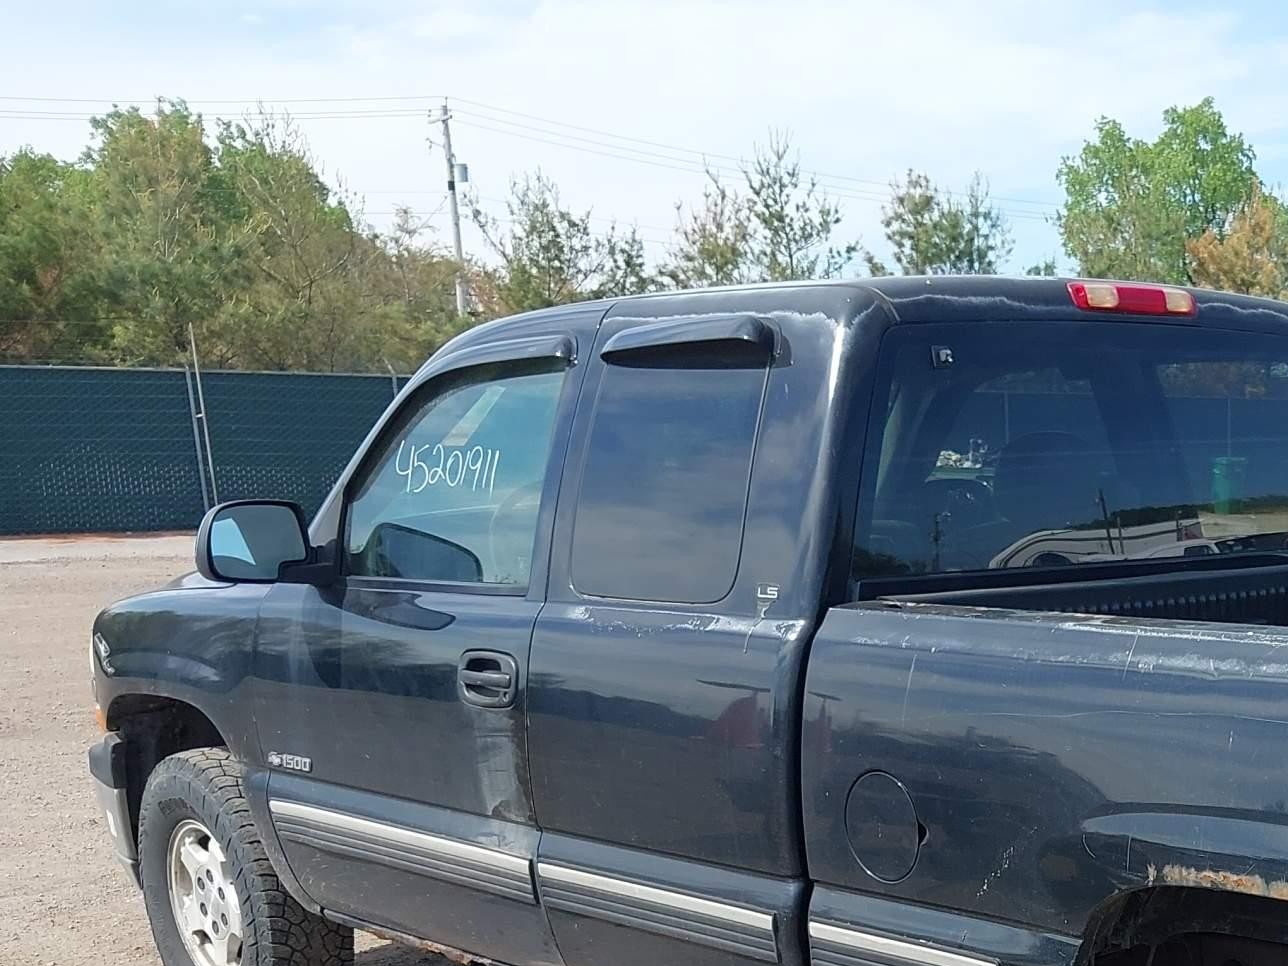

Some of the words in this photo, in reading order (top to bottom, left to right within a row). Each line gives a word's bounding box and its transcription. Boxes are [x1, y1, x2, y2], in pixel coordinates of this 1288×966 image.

[395, 439, 500, 498] 45201911
[757, 586, 779, 599] LS
[282, 753, 312, 772] 1500
